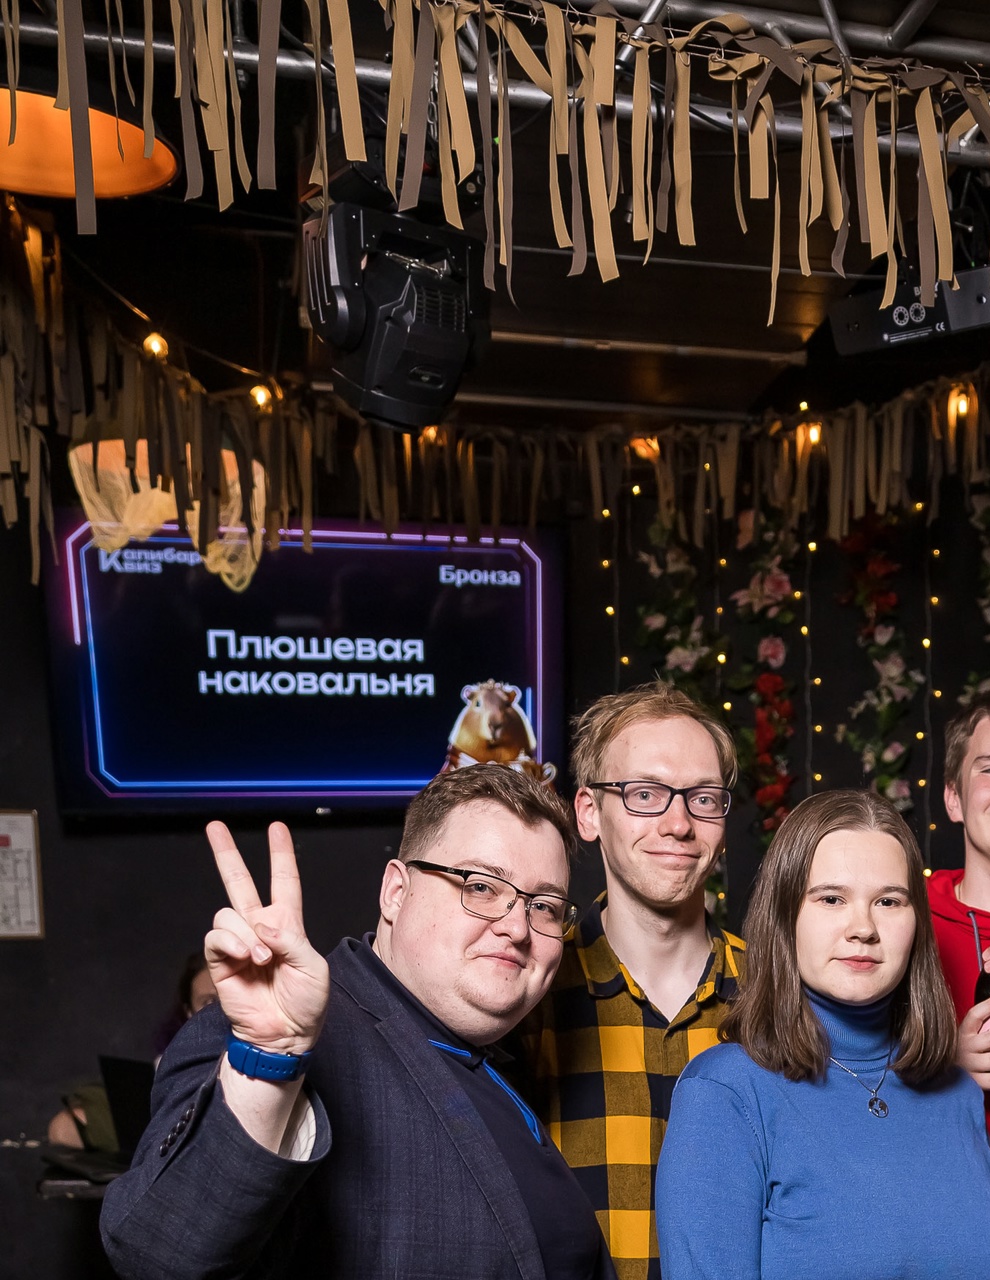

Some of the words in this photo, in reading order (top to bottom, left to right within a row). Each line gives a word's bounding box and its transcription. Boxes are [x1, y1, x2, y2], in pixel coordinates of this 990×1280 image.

[98, 546, 202, 573] Капибар
[439, 564, 521, 588] Бронза
[206, 629, 425, 662] Плюшевая
[198, 670, 435, 696] наковальня
